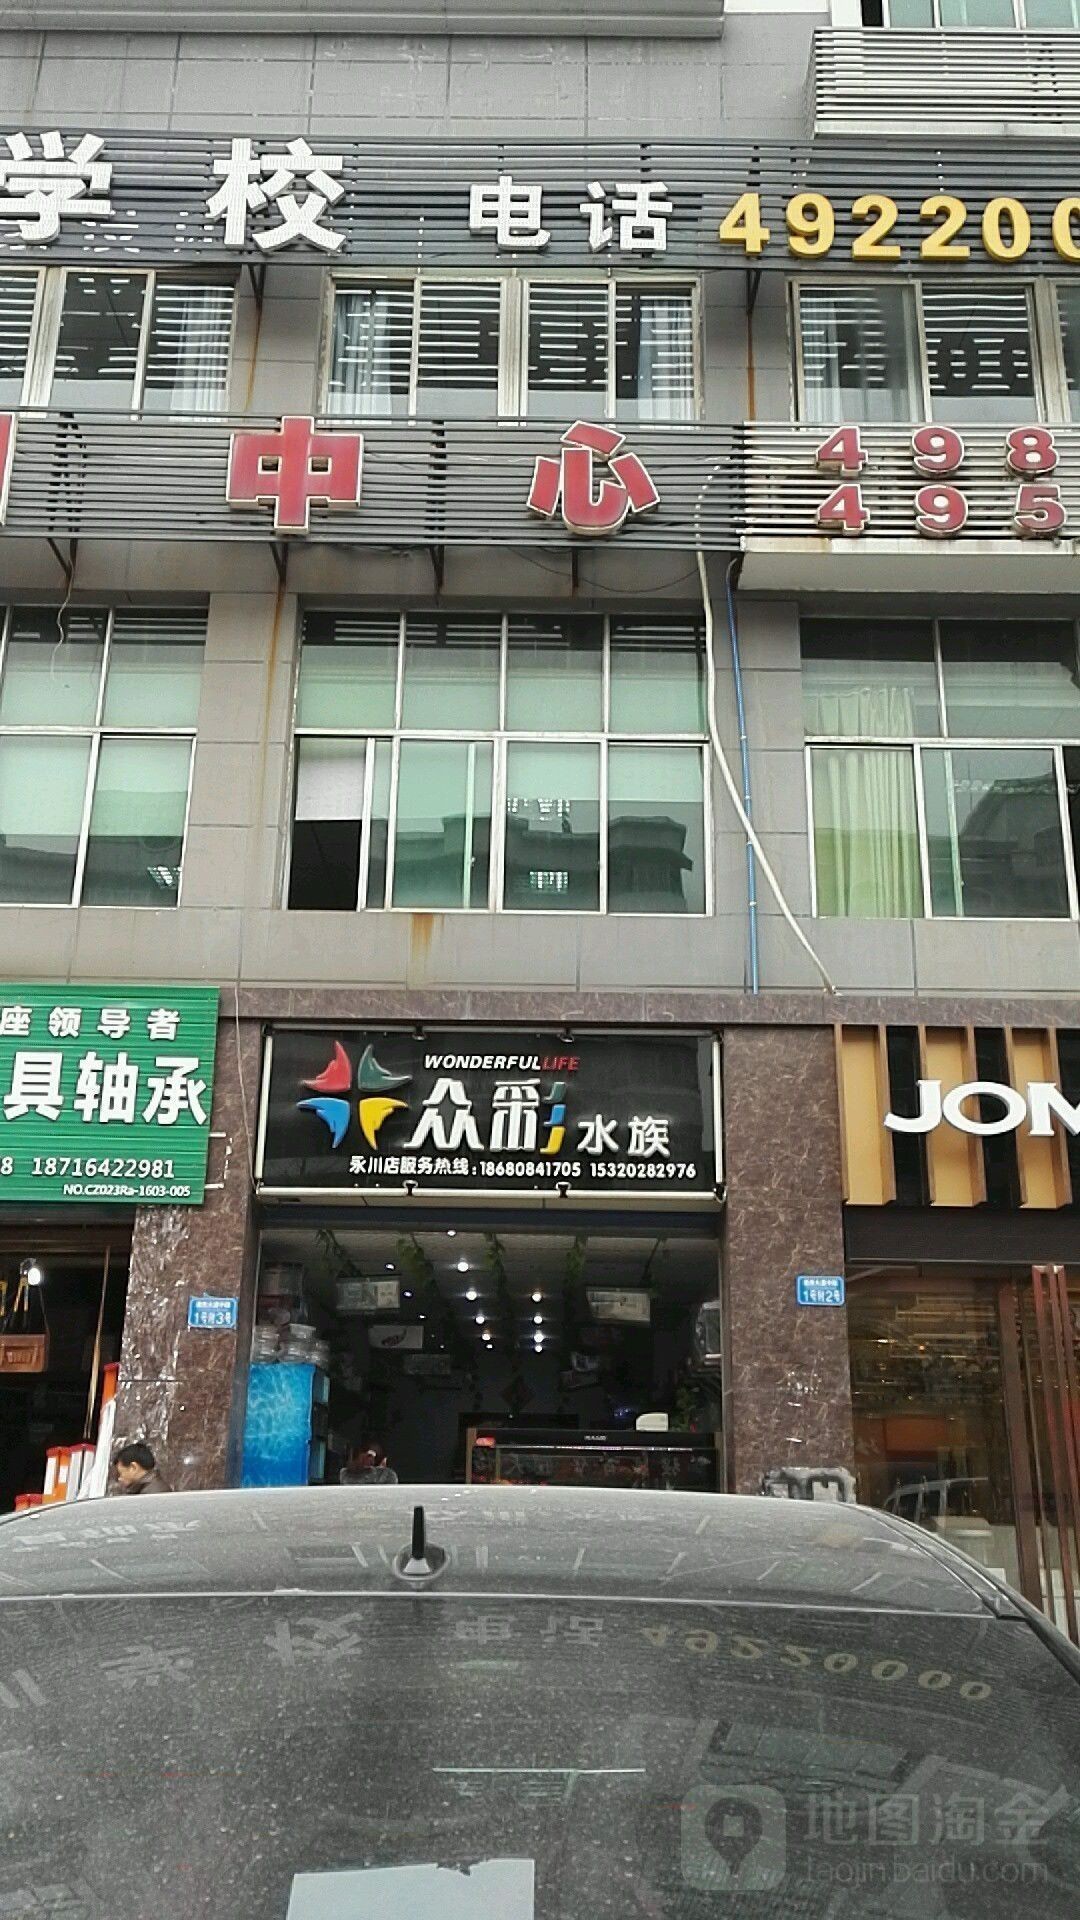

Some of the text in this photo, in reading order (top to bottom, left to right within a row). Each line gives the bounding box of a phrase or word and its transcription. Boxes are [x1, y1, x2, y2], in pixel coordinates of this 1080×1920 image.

[468, 174, 673, 253] 电话
[815, 426, 1060, 481] 498
[815, 484, 1068, 538] 495
[0, 1005, 180, 1041] 座领导者
[3, 1051, 208, 1126] 具轴承
[884, 1079, 1080, 1137] JOM
[31, 1157, 175, 1179] 18716422981
[590, 1162, 697, 1179] 15320282976
